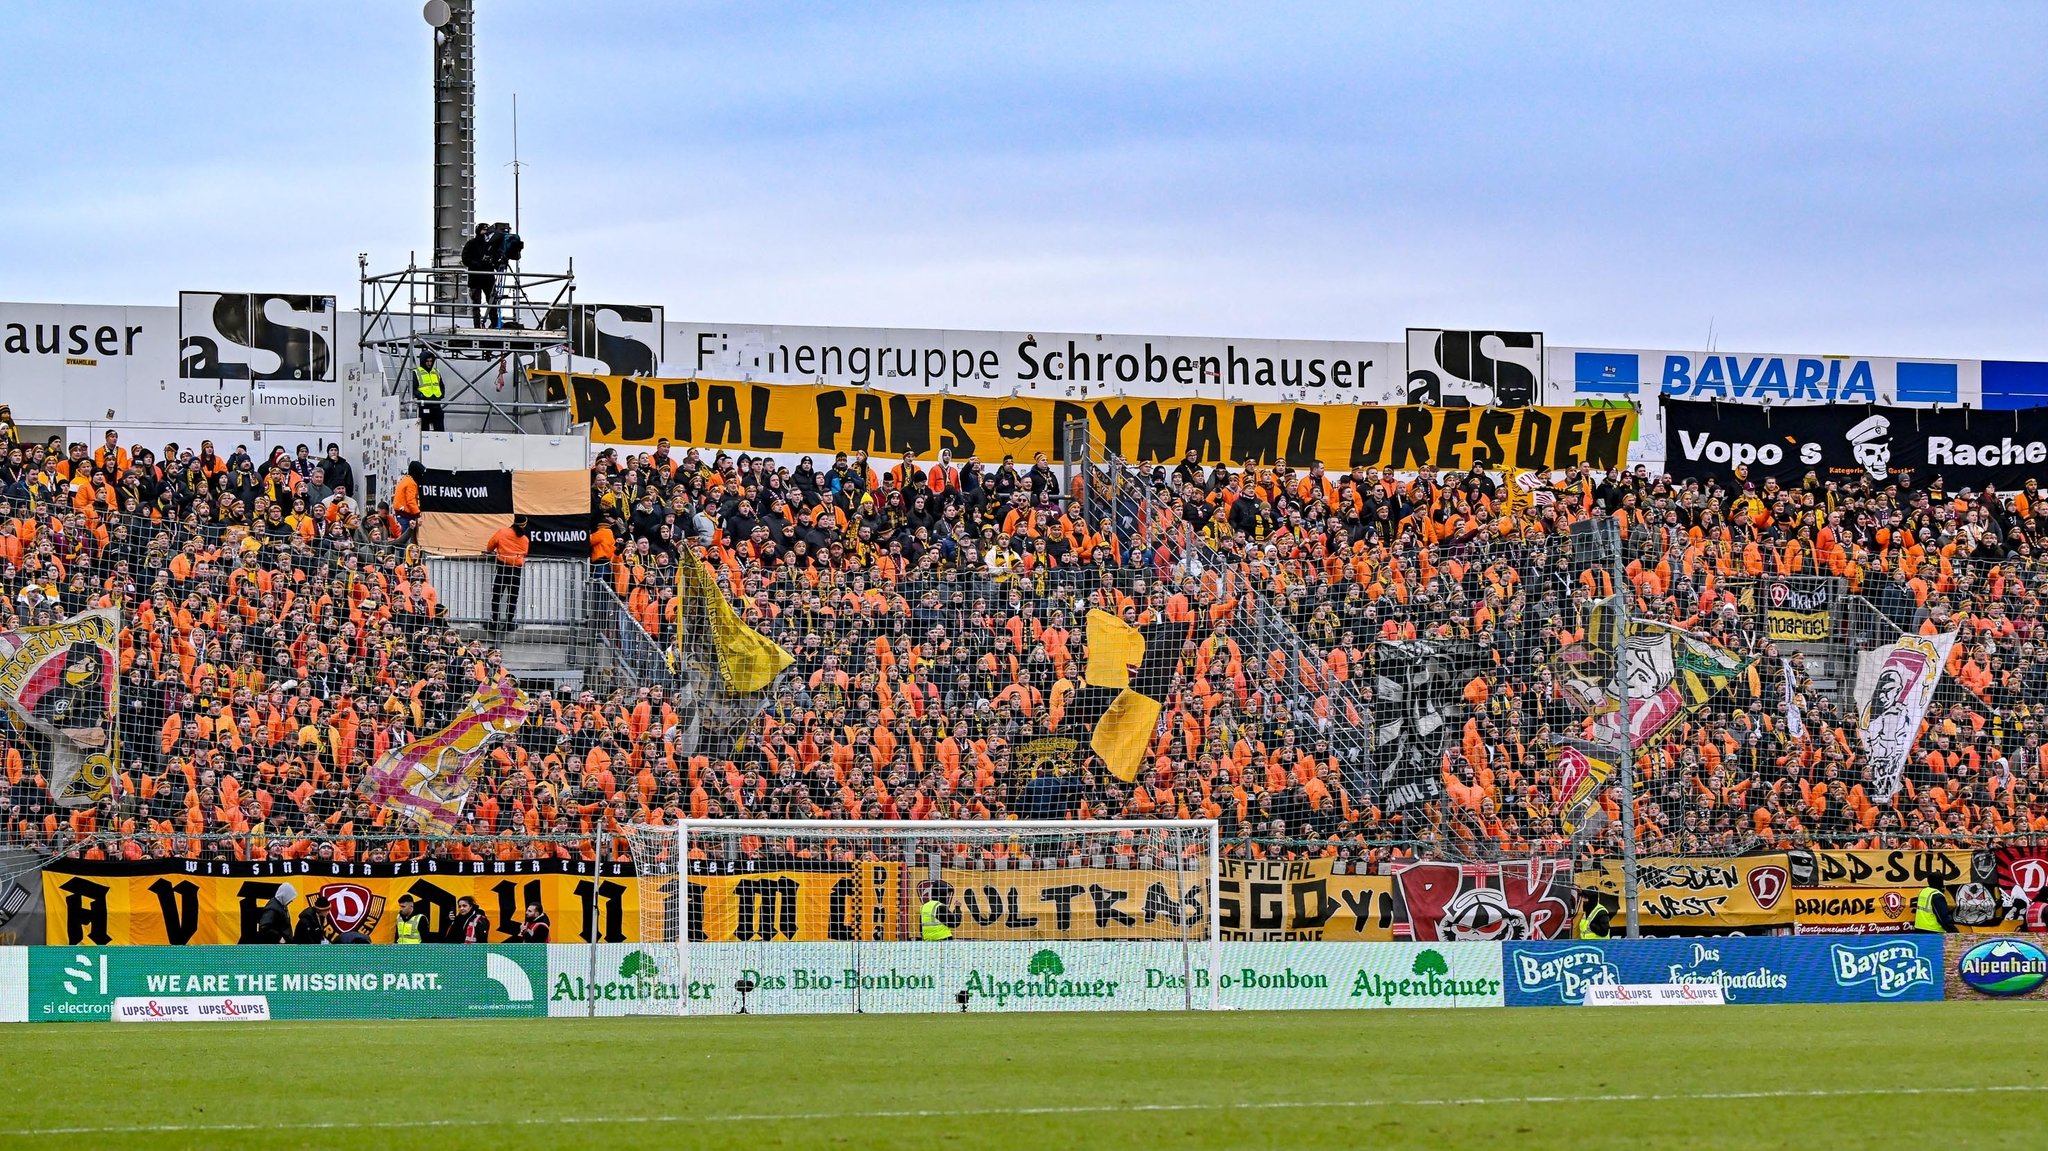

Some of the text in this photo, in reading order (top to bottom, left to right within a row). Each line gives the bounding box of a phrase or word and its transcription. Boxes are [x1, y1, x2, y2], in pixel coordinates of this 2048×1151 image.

[1017, 340, 1373, 388] Schrobenhauser
[1660, 354, 1876, 400] BAVARIA
[179, 391, 335, 407] Bauträger Immobilien
[816, 390, 977, 459] FANS
[1350, 405, 1627, 471] DRESDEN
[1927, 436, 2047, 466] Rache
[422, 485, 488, 498] DIE FANS VOM
[530, 530, 587, 542] FC DYNAMO
[185, 860, 230, 875] WIR
[252, 860, 310, 875] SIND
[332, 862, 372, 876] DIR
[393, 859, 437, 875] FÜR
[458, 860, 541, 873] IMMER
[643, 860, 755, 874] EREBEN
[964, 881, 1204, 931] ULTRAS
[1642, 894, 1728, 919] WEST
[1795, 897, 1876, 916] BRIGADE
[1689, 943, 1720, 967] Das
[1836, 946, 1915, 979] Bayern
[1963, 958, 2047, 976] Alpenhain
[793, 969, 935, 989] Bio-Bonbon
[1195, 968, 1328, 989] Bo-Bonbon
[1519, 952, 1602, 985] Bayern
[1563, 964, 1617, 997] Park
[1879, 959, 1930, 991] Park
[147, 973, 442, 993] WE ARE THE MISSING PART.
[966, 970, 1118, 1006] Alpenbauer
[1351, 969, 1500, 1005] Alpenbauer
[58, 1002, 113, 1014] electroni
